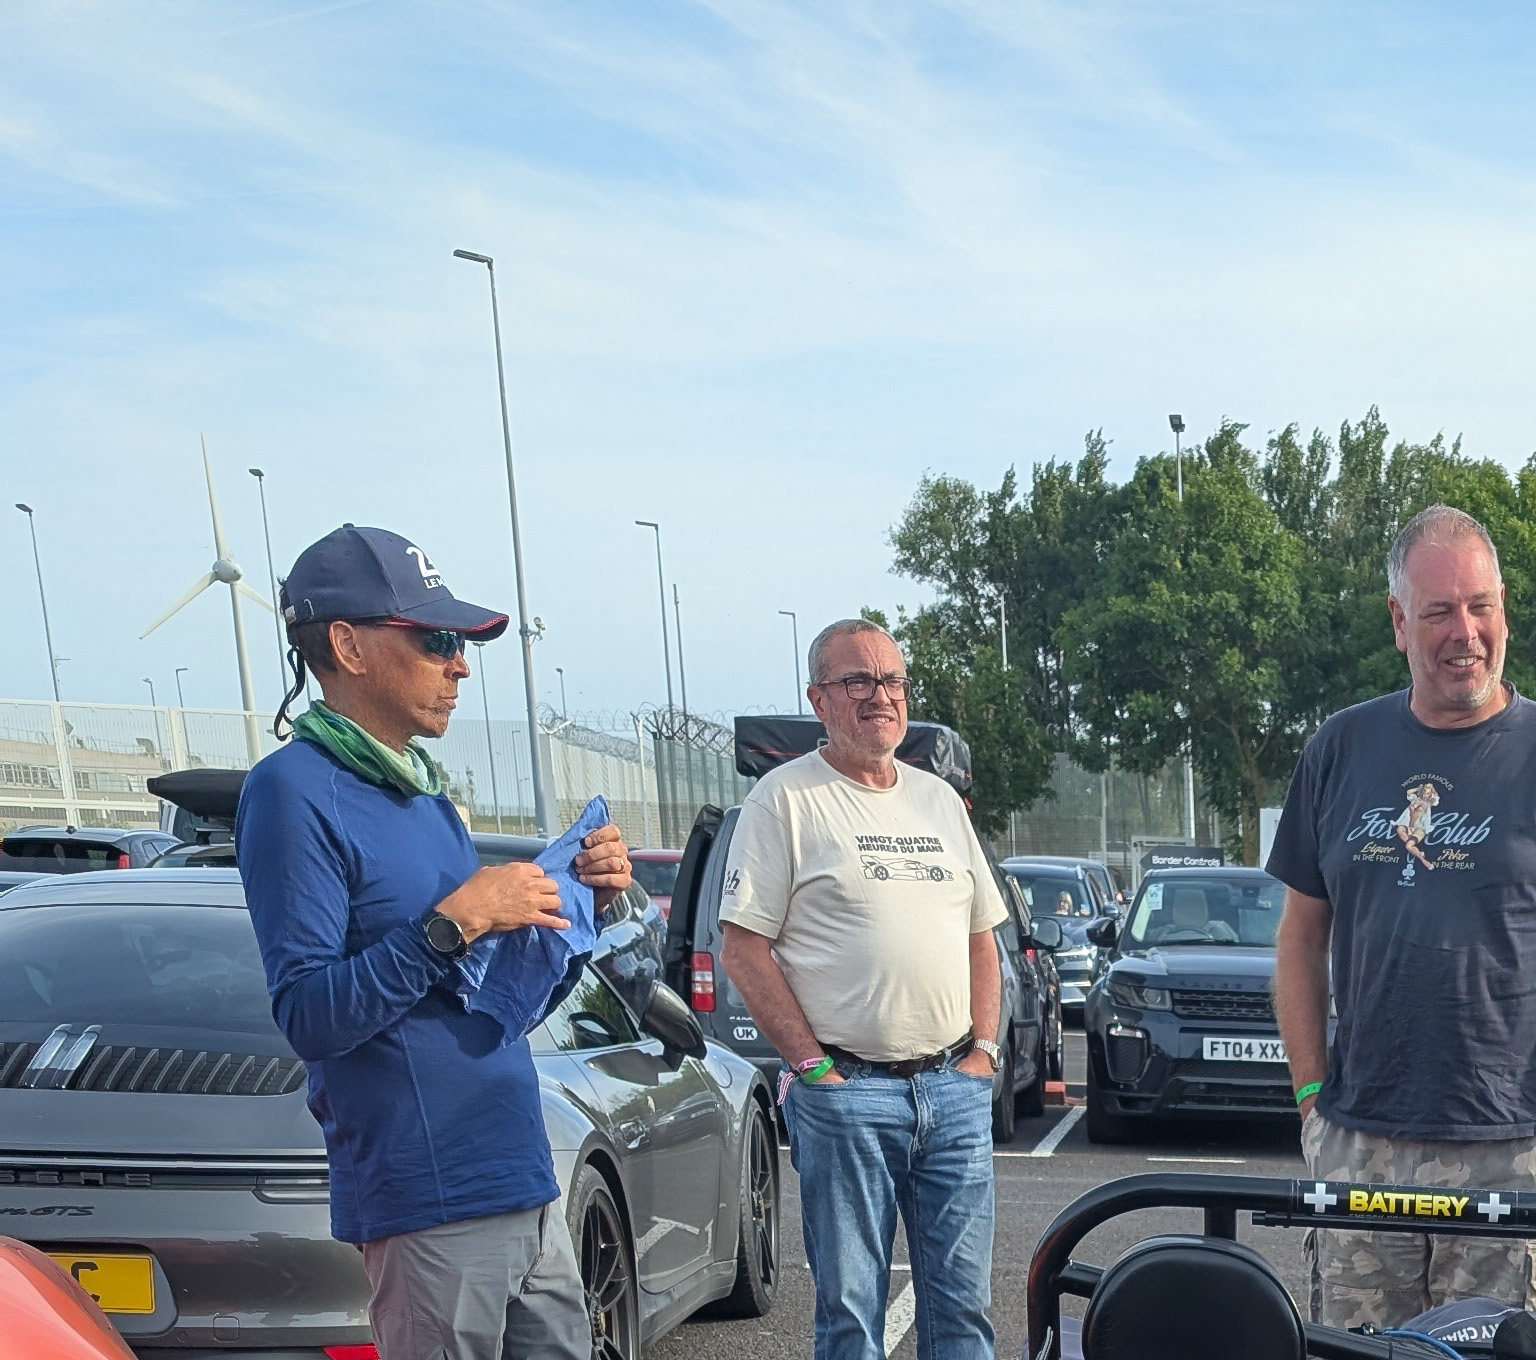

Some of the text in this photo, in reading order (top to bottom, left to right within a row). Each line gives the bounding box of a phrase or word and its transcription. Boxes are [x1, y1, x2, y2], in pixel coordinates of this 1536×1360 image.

[1346, 807, 1494, 846] Fox Club
[857, 843, 898, 853] HEURES
[917, 845, 944, 853] MANS
[1152, 856, 1183, 865] Border
[1376, 855, 1400, 863] FRONT
[1441, 861, 1454, 869] THE
[1455, 862, 1475, 870] REAR
[735, 1028, 755, 1039] UK
[1210, 1041, 1254, 1059] FT04
[1349, 1190, 1470, 1217] BATTERY
[30, 1205, 95, 1216] GTS
